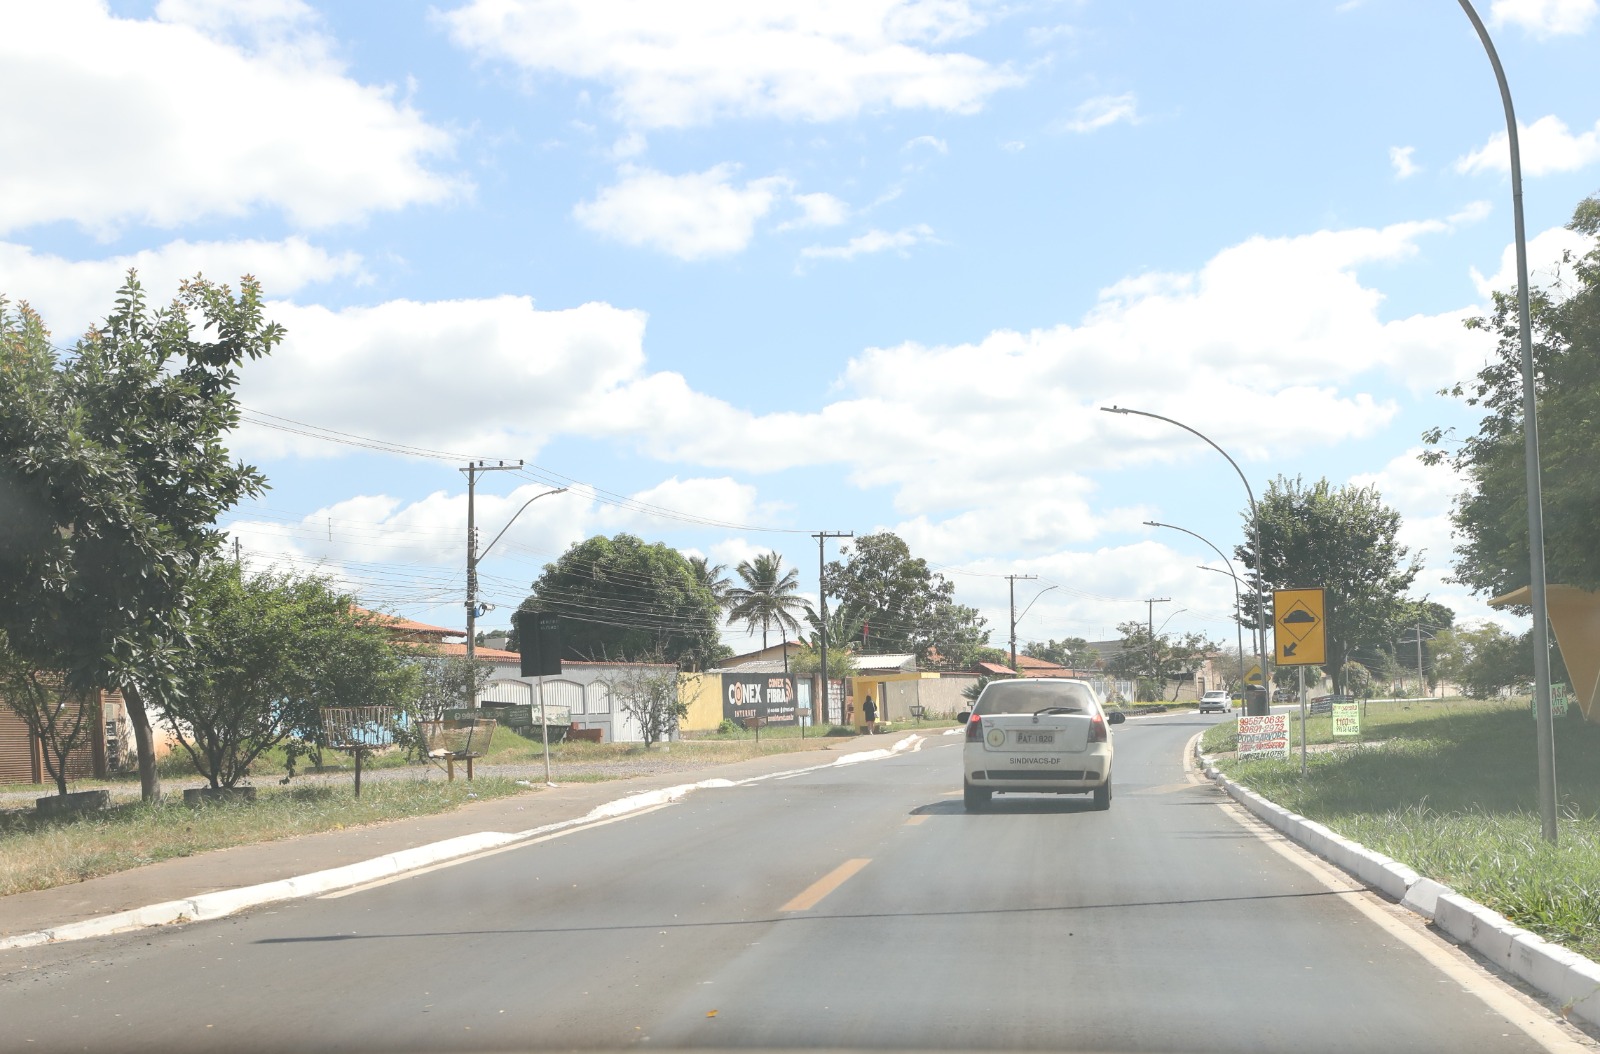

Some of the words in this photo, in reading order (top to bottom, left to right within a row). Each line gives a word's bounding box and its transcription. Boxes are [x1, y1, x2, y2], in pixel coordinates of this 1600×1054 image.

[768, 678, 784, 688] CONEX
[728, 682, 762, 705] CONEX
[766, 688, 786, 703] FIBRA
[1239, 715, 1286, 726] 99567-0632
[1009, 757, 1062, 765] SINDIVACS-DF
